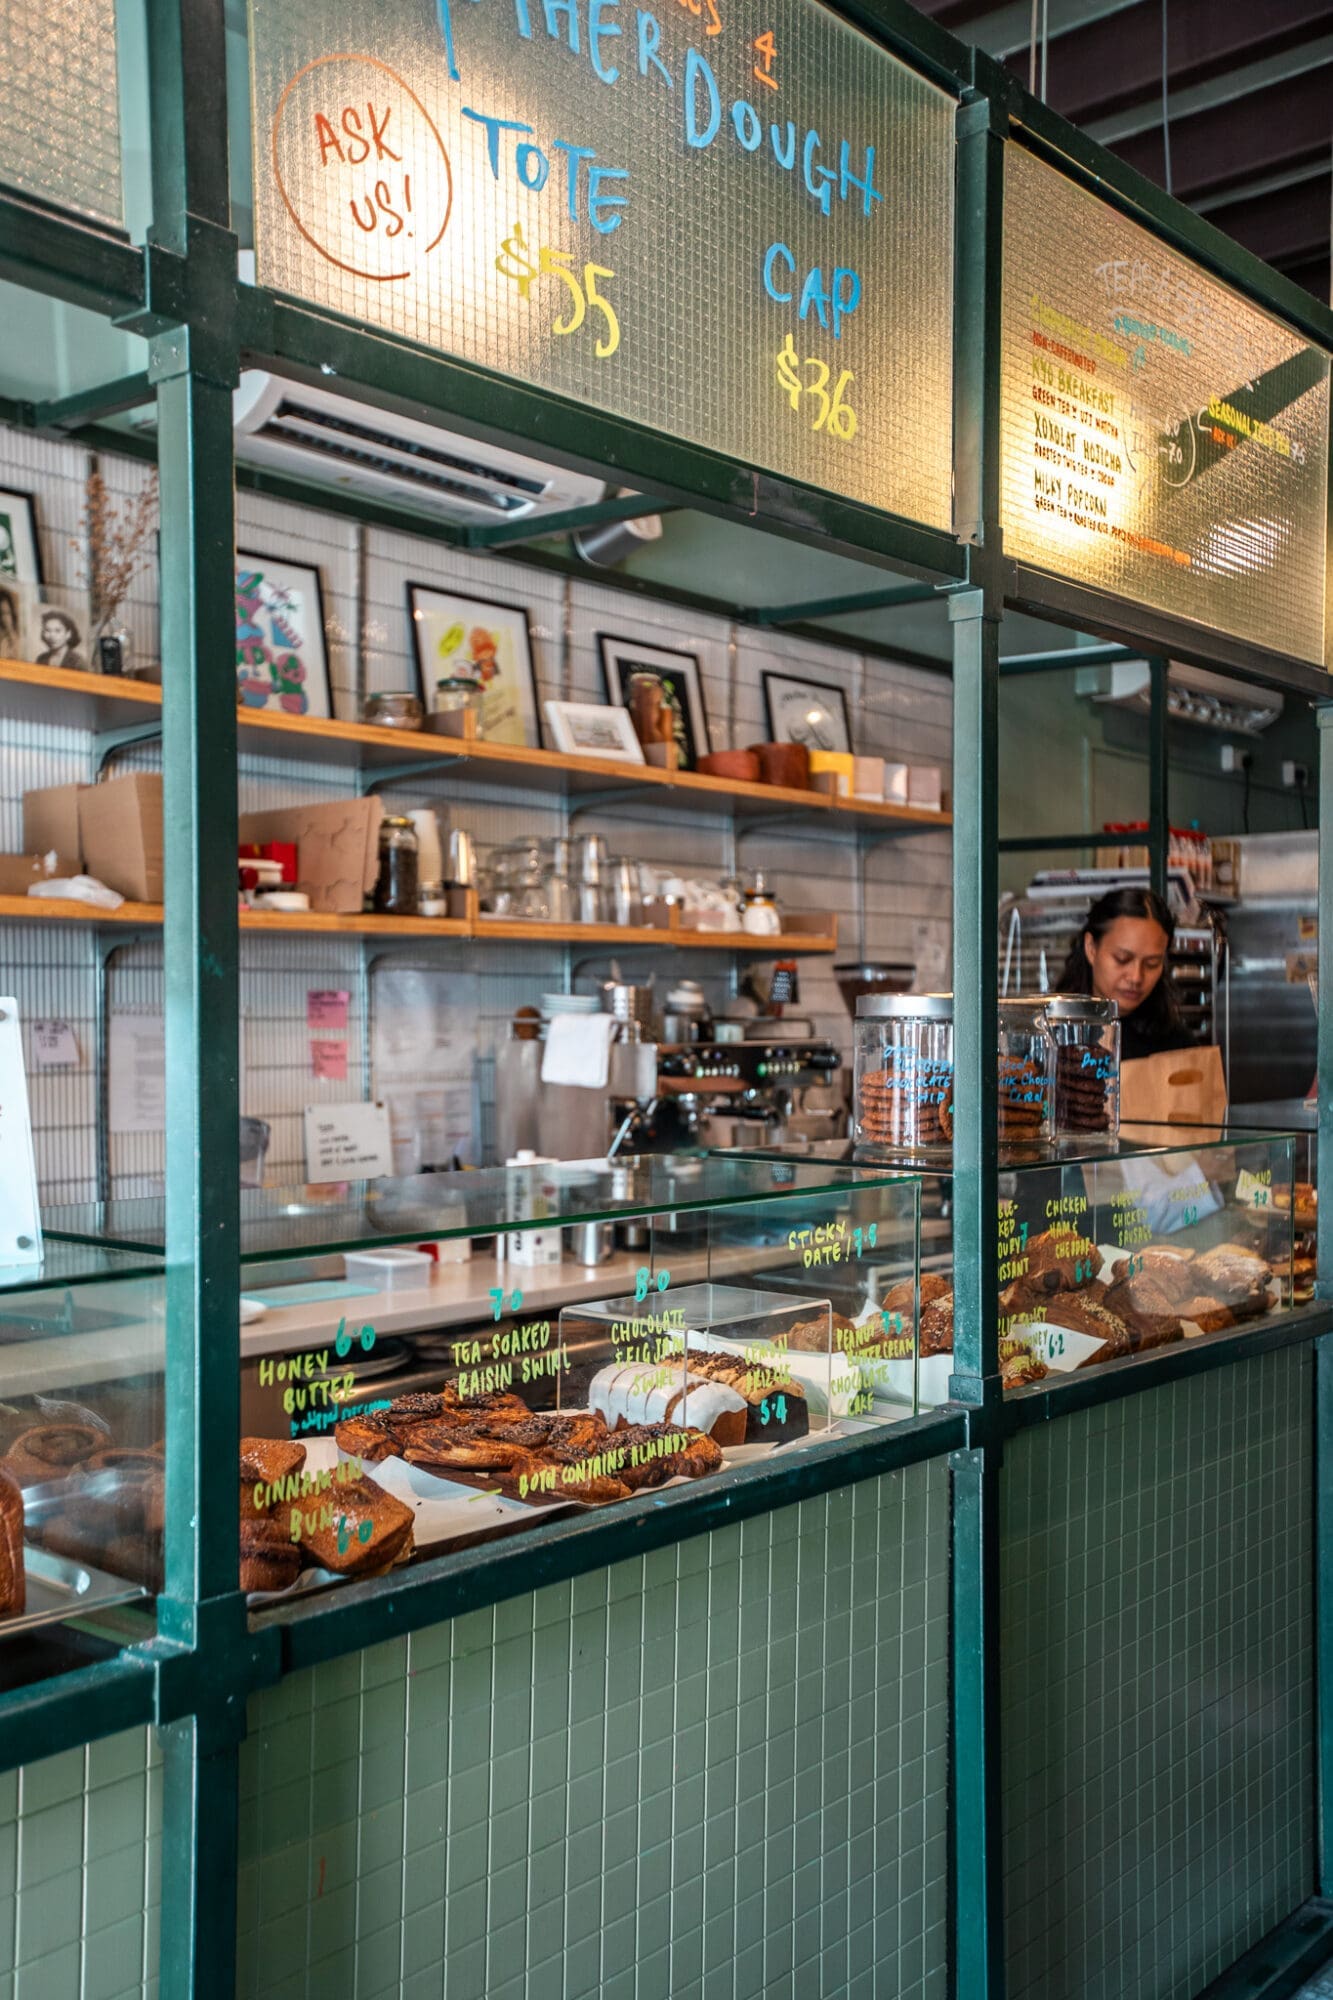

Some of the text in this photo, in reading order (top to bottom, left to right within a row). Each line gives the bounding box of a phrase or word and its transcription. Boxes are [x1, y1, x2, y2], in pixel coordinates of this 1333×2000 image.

[315, 103, 402, 167] ASK
[461, 106, 630, 235] TOTE
[350, 175, 415, 238] US!
[495, 223, 621, 359] $55
[764, 242, 862, 340] CAP
[776, 333, 858, 441] $36
[1032, 385, 1056, 407] GREEN
[1058, 366, 1115, 415] BREAKFAST
[1208, 395, 1251, 437] SEASONAL
[1083, 439, 1122, 475] HOJICHA
[1034, 468, 1108, 518] MILKY POPCORN
[1034, 494, 1055, 512] GREEN
[906, 1089, 946, 1105] CHIP
[1045, 1195, 1087, 1218] CHICKEN
[1112, 1206, 1148, 1229] CHICKEN
[788, 1220, 847, 1251] STICKY
[1049, 1220, 1071, 1239] HAM
[635, 1266, 671, 1302] 8.0
[489, 1287, 524, 1321] 7.0
[335, 1316, 376, 1358] 6.0
[451, 1320, 550, 1367] TEA-SOAKED
[611, 1308, 686, 1345] CHOCOLATE
[836, 1324, 875, 1351] PEANUT
[626, 1342, 650, 1369] FIG
[653, 1335, 685, 1363] JAM
[883, 1338, 915, 1360] CREAM
[1048, 1333, 1064, 1359] 6.2
[259, 1350, 329, 1387] HONEY
[458, 1342, 571, 1401] RAISIN SWIRL
[632, 1366, 676, 1397] SWIRL
[830, 1364, 890, 1396] CHOCOLATE
[283, 1371, 356, 1415] BUTTER
[760, 1394, 788, 1426] 5.4
[847, 1391, 874, 1417] CAKE
[253, 1454, 363, 1510] CINNAMON
[519, 1432, 688, 1499] BOTH CONTAINS ALMONDS
[290, 1501, 334, 1543] BUN
[337, 1514, 374, 1555] 6.0
